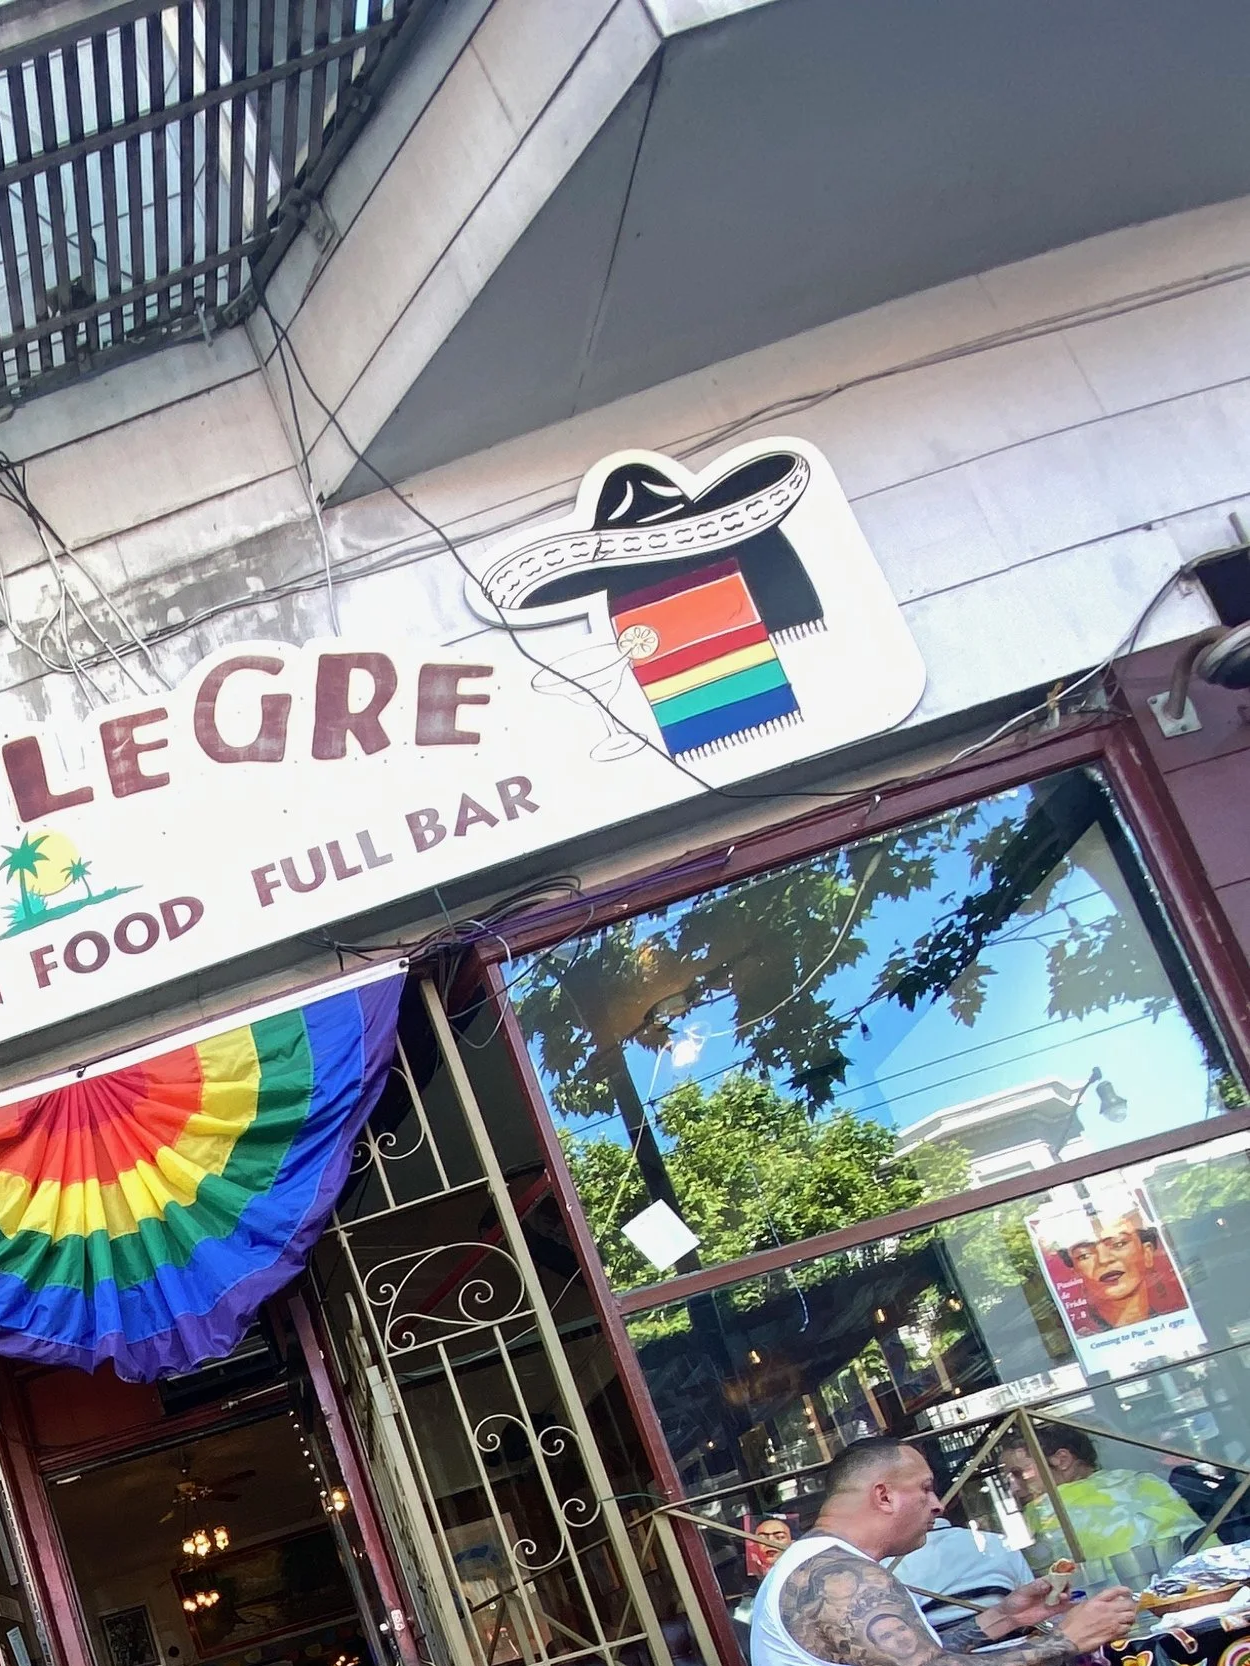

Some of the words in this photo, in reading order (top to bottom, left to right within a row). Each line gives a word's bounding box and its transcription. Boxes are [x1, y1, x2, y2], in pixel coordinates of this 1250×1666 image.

[29, 896, 205, 988] FOOD
[251, 830, 393, 908] FULL
[404, 776, 540, 853] BAR
